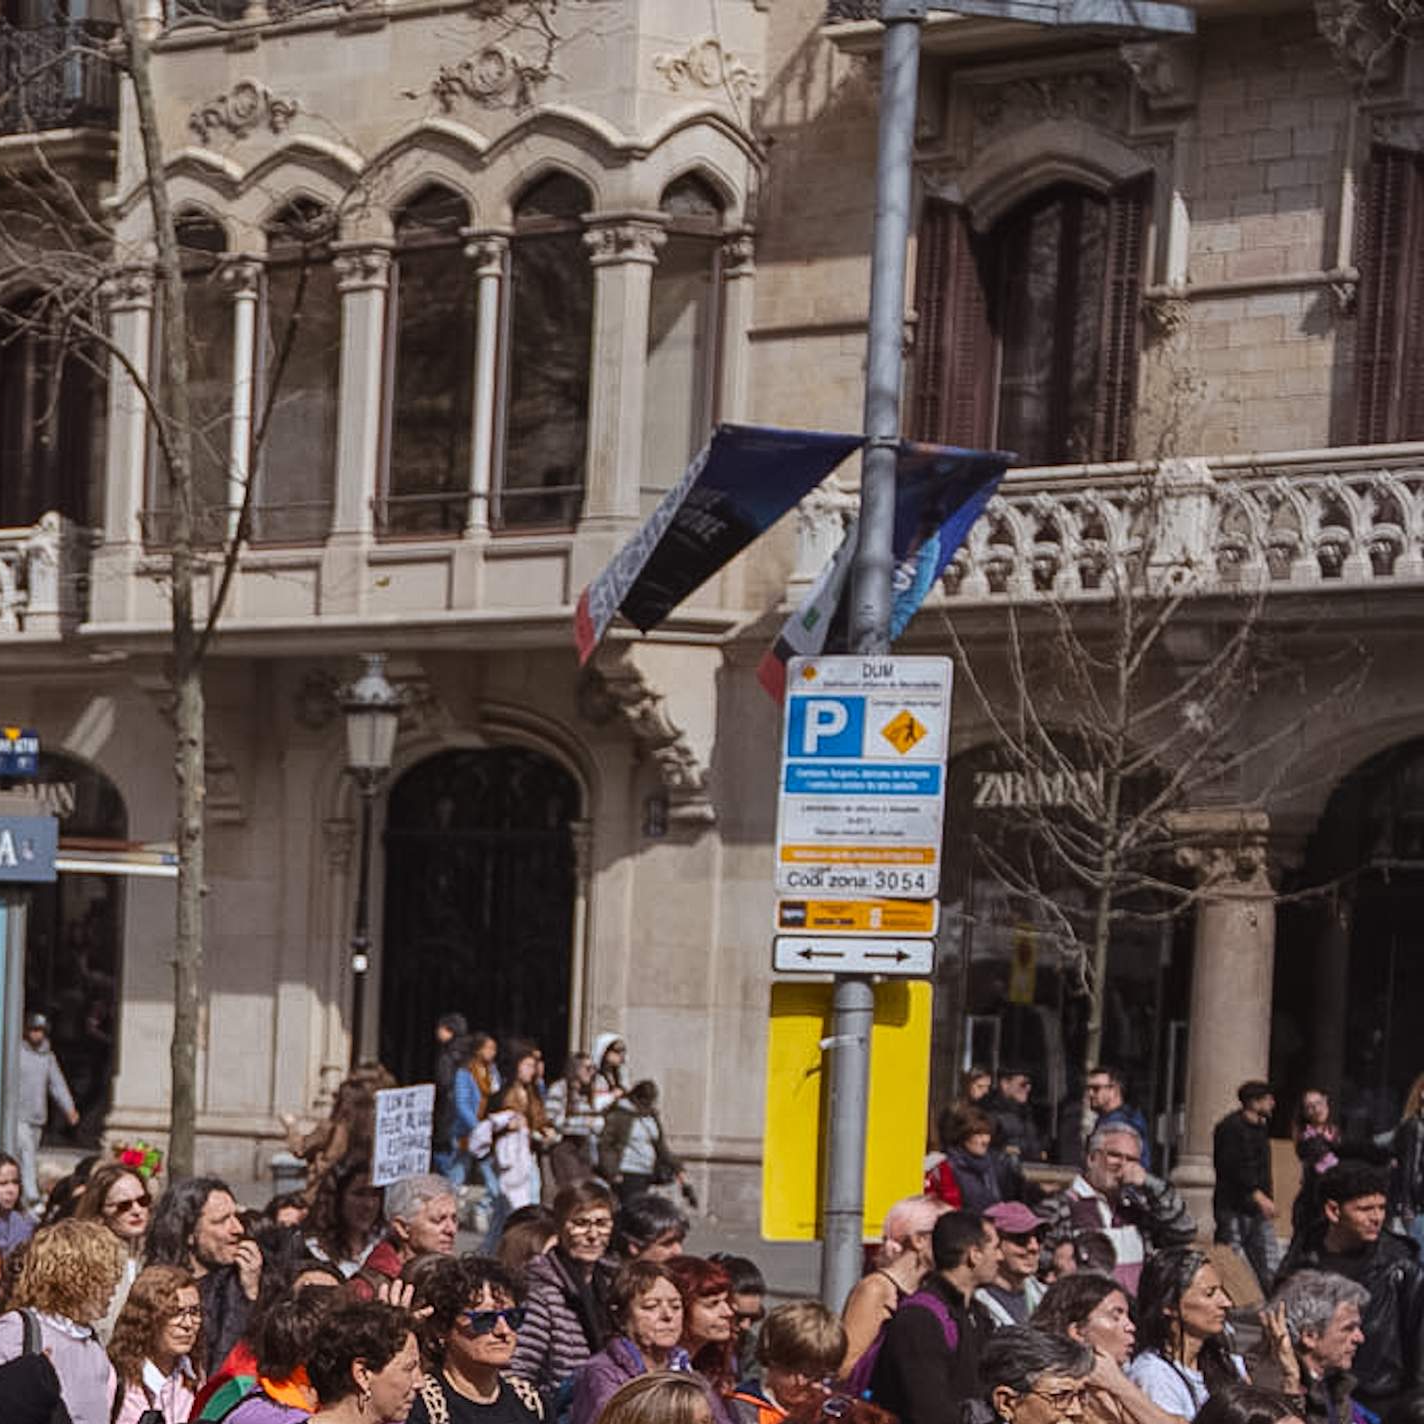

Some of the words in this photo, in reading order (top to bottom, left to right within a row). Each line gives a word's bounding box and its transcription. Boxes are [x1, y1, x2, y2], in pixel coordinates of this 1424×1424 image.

[862, 663, 895, 679] DUM
[802, 698, 849, 755] P
[786, 870, 823, 888] Codi
[874, 870, 927, 891] 3054
